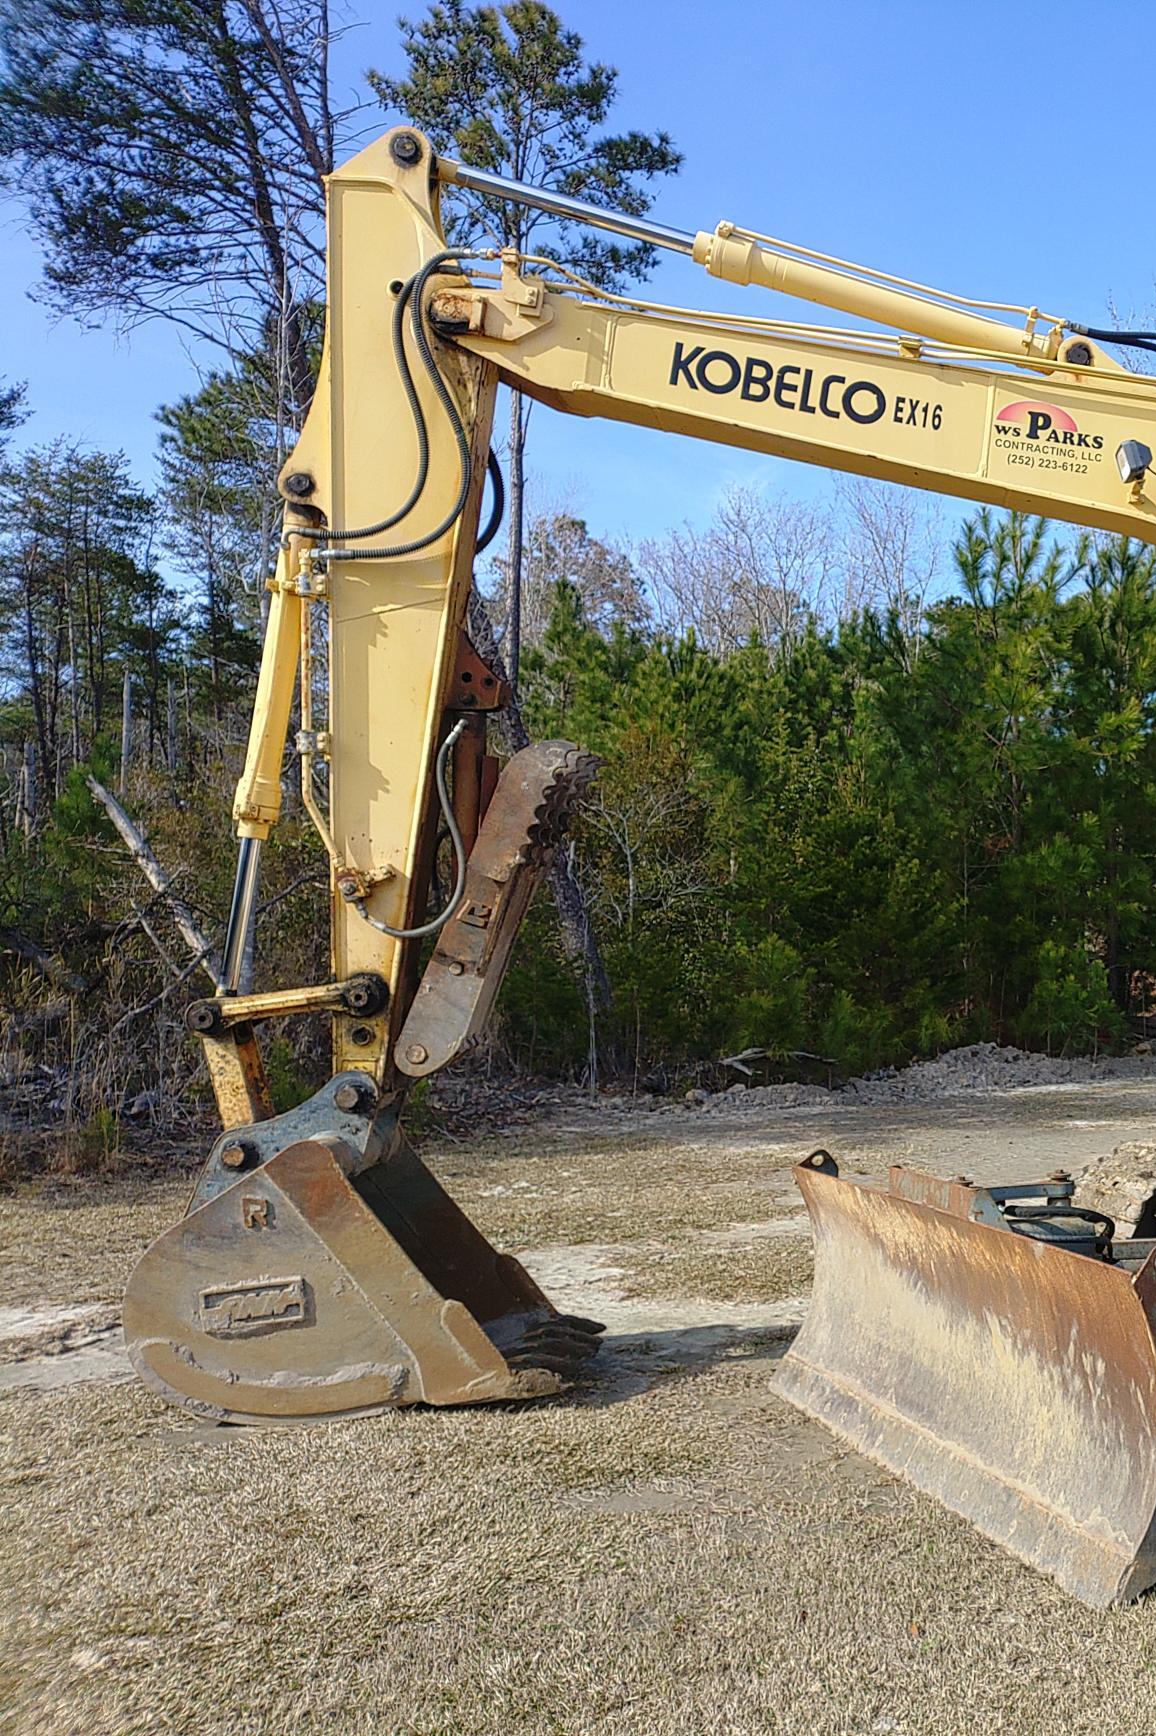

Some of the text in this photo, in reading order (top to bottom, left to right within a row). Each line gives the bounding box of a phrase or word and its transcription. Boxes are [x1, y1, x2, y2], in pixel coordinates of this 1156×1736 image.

[669, 342, 943, 430] KOBELCO EX16
[1026, 411, 1104, 449] PARKS
[995, 439, 1102, 462] CONTRACTING, LLC
[1007, 454, 1088, 474] (252) 223-6122
